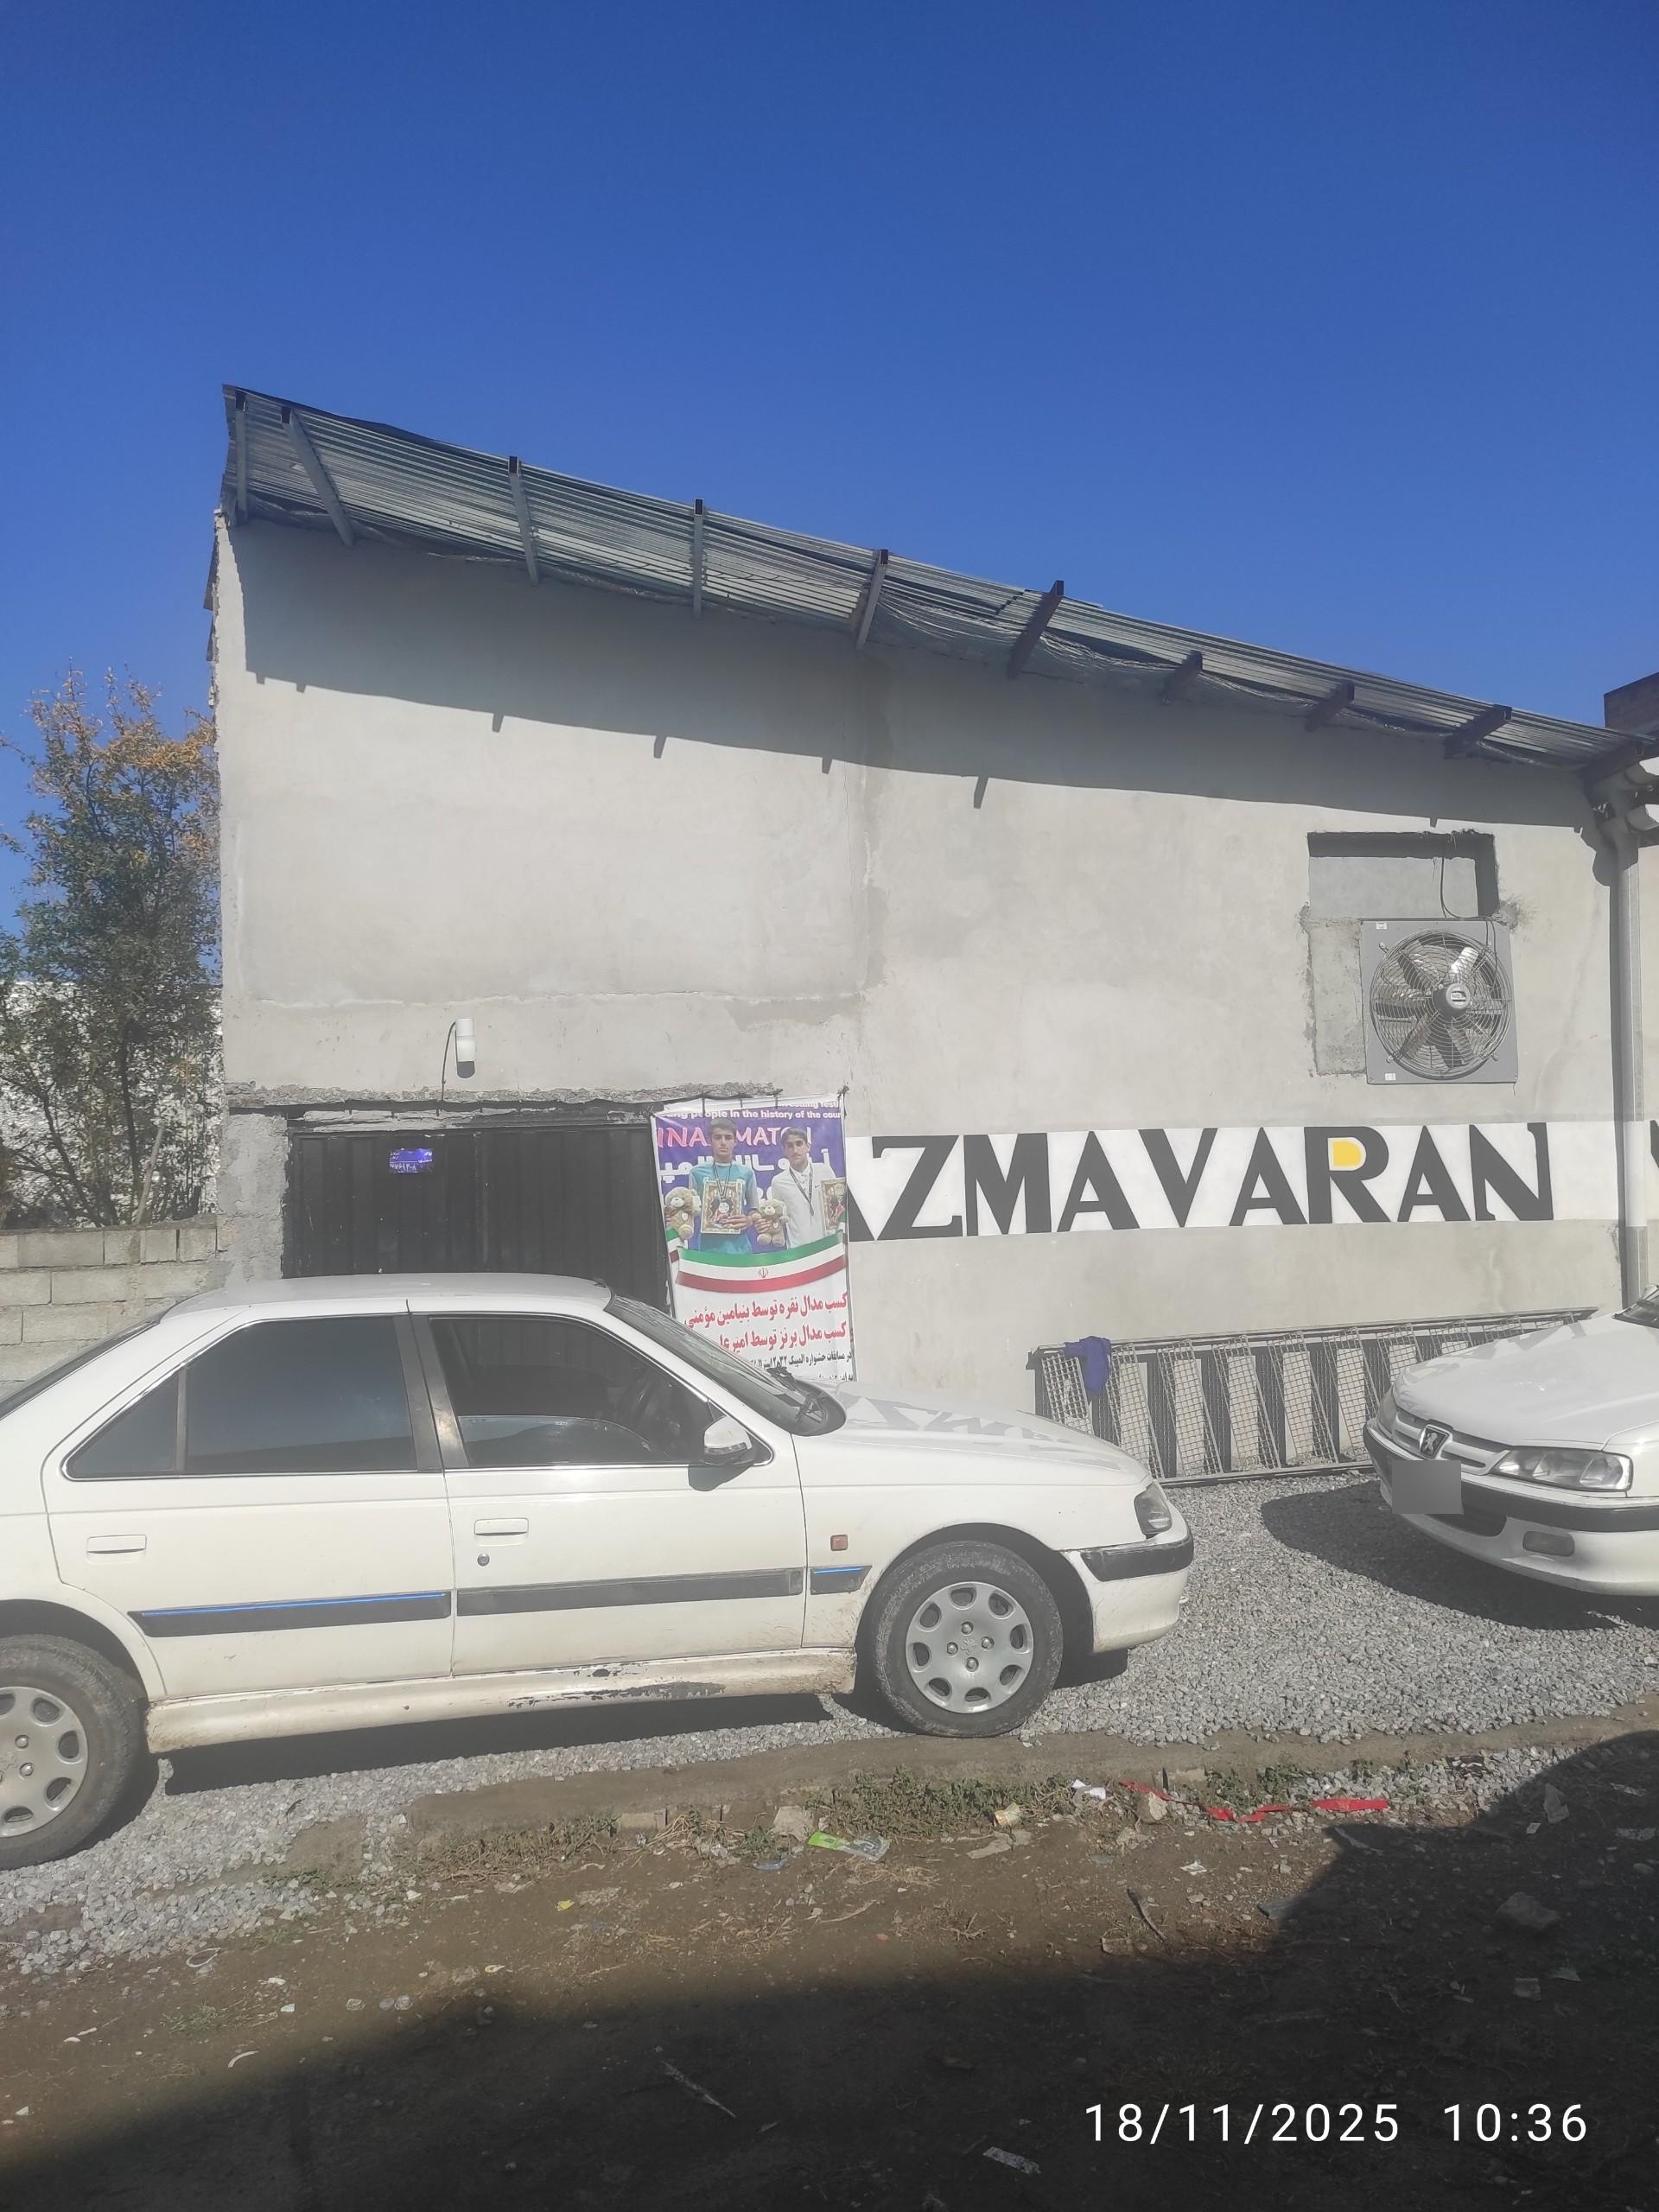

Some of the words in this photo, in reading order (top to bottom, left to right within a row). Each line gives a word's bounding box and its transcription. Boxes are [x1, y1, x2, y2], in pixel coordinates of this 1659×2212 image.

[730, 1109, 740, 1118] in
[742, 1109, 759, 1118] the
[760, 1109, 792, 1121] history
[717, 1302, 750, 1326] بنیامین
[752, 1300, 778, 1320] توسط
[779, 1297, 798, 1319] نقره
[800, 1294, 823, 1317] مدال
[824, 1292, 848, 1314] کسب
[732, 1332, 748, 1352] امیر
[750, 1329, 777, 1351] توسط
[779, 1327, 797, 1349] برنز
[799, 1325, 822, 1346] مدال
[823, 1320, 846, 1343] کسب
